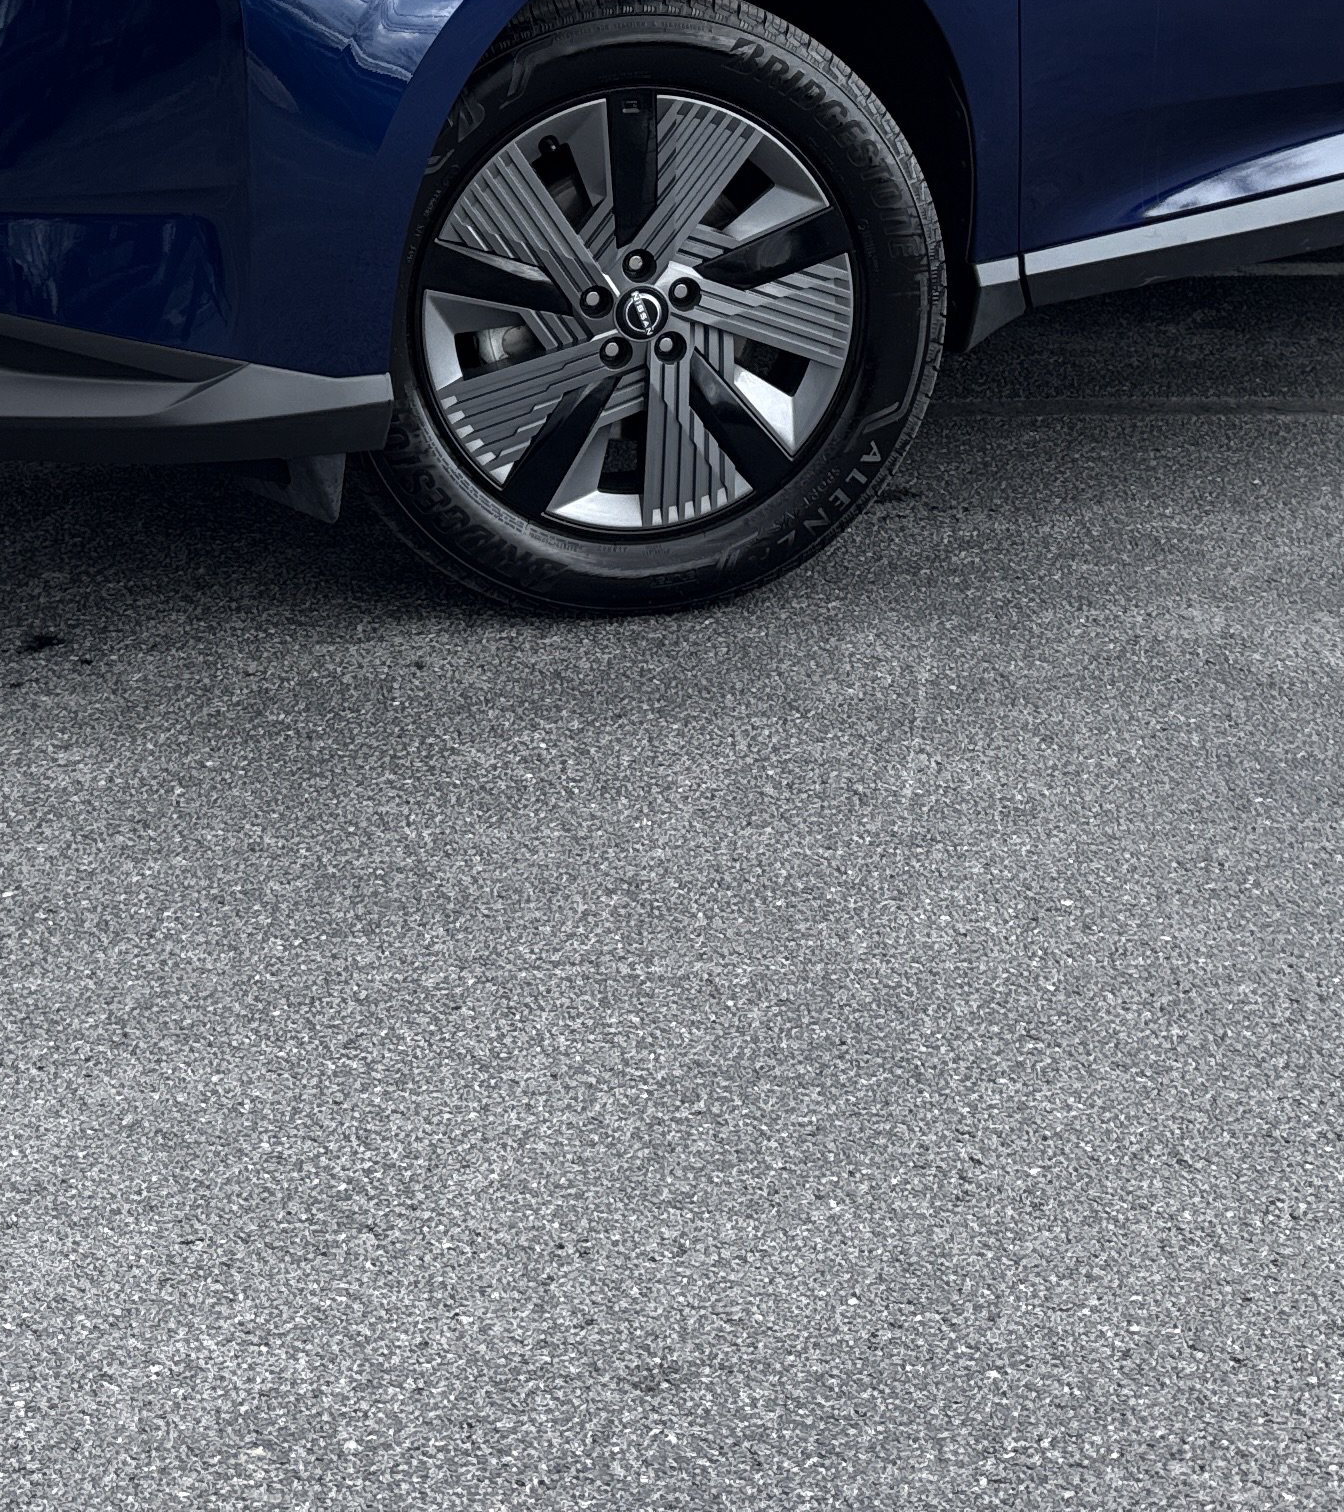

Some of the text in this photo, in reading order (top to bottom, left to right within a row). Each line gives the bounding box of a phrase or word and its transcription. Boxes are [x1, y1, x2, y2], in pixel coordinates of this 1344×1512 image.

[722, 37, 914, 260] BRIDGESTONE
[630, 291, 654, 335] NISSAN
[386, 418, 568, 592] BRIDGESTO
